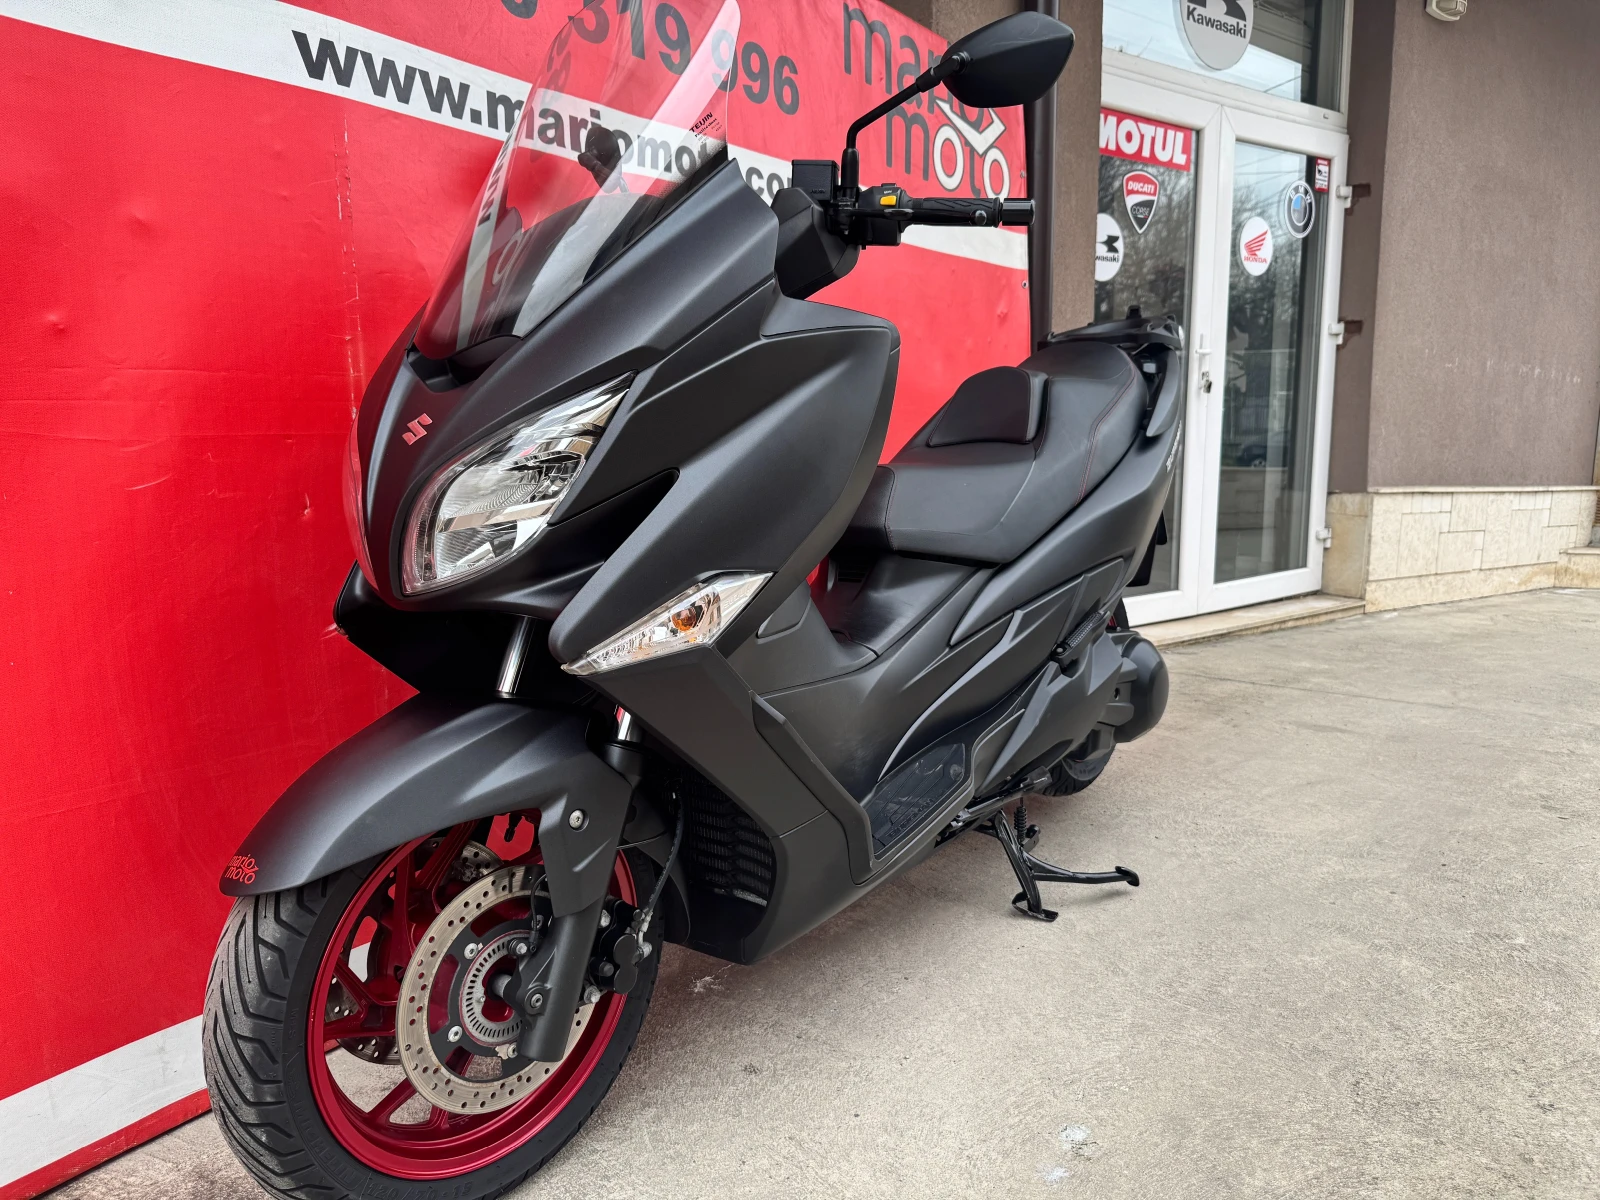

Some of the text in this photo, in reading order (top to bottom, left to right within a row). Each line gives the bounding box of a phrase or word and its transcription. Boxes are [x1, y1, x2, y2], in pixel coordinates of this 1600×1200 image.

[1186, 4, 1247, 39] Kawasaki
[711, 29, 799, 115] 996
[688, 112, 713, 133] TEIJIN
[1098, 113, 1187, 166] MOTUL
[1127, 180, 1155, 194] DUCATI
[1131, 204, 1150, 216] CORSE
[1243, 255, 1268, 264] HONDA
